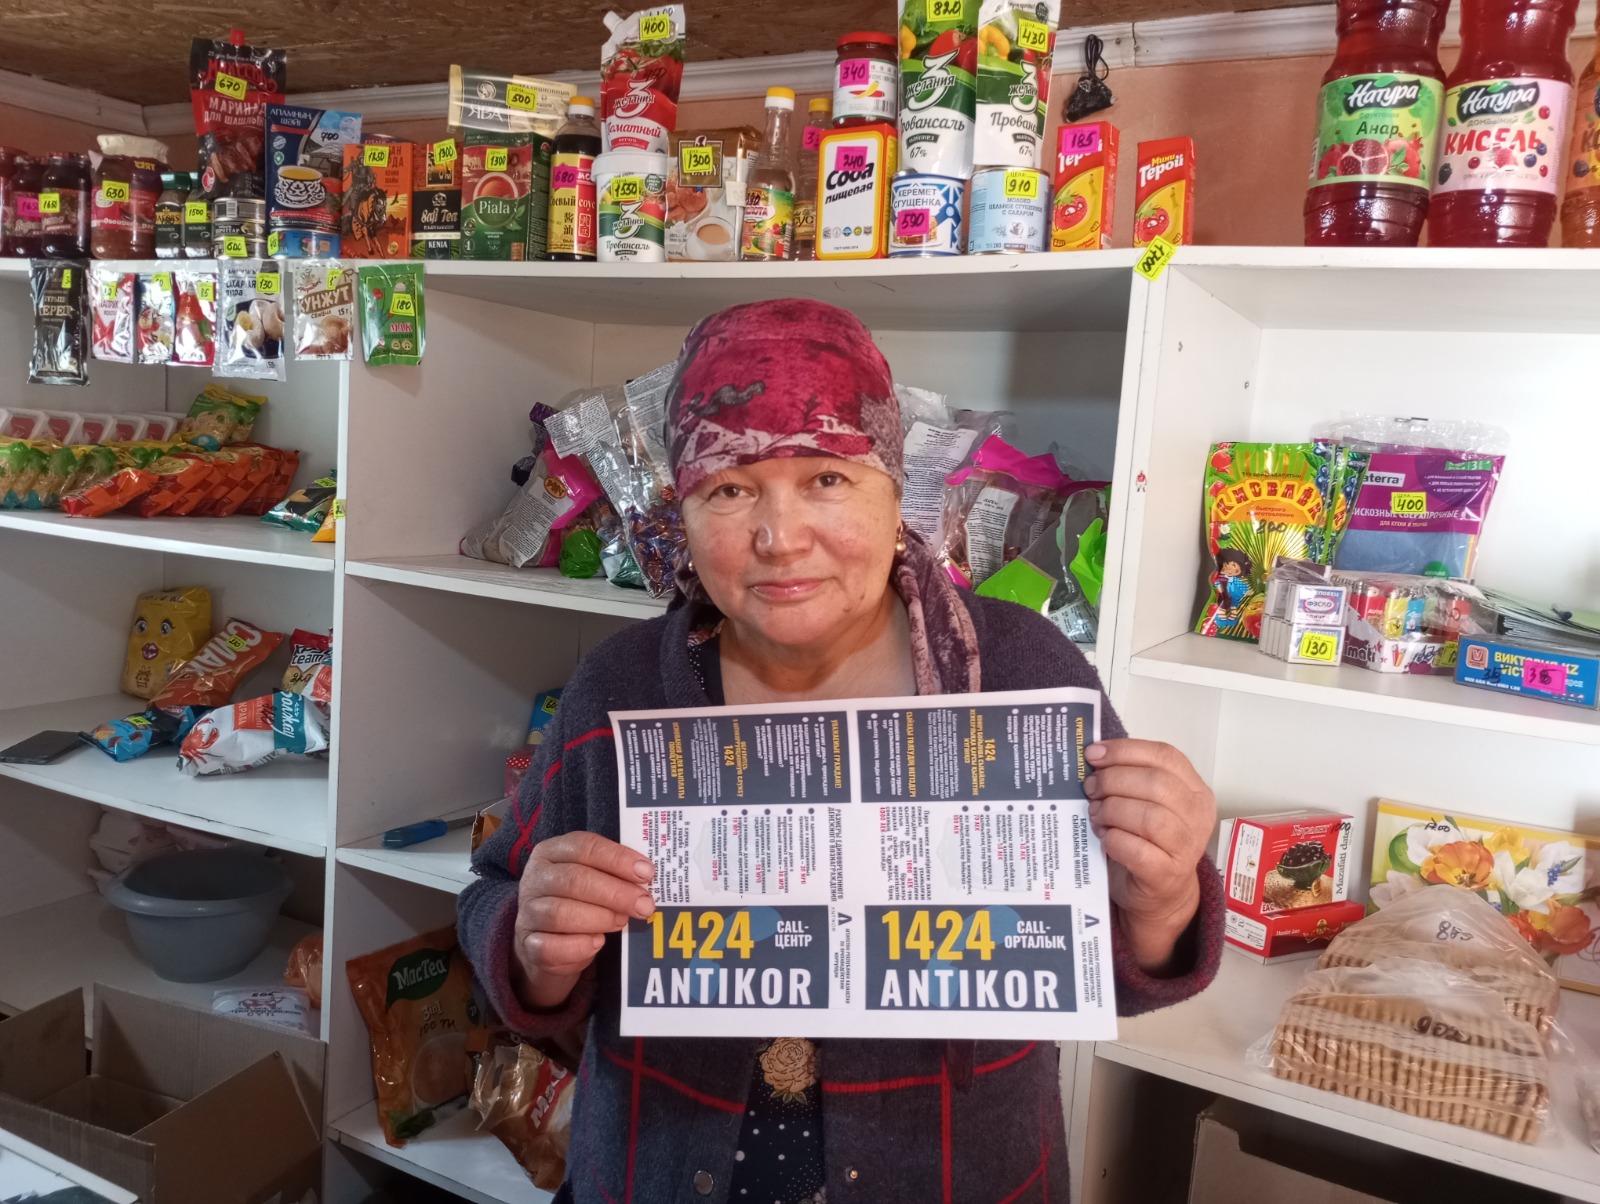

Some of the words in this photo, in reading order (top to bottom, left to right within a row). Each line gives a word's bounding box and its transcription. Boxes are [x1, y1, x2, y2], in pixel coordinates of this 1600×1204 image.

[933, 1, 961, 16] 820
[644, 20, 666, 34] 400
[1022, 28, 1046, 45] 430
[842, 64, 866, 80] 340
[218, 78, 240, 91] 670
[906, 74, 956, 98] желания
[908, 48, 960, 112] 3
[615, 78, 657, 118] 3
[1009, 84, 1038, 98] желан
[1347, 82, 1419, 108] Натура
[512, 94, 531, 104] 500
[614, 95, 655, 108] желания
[1461, 86, 1537, 116] Натура
[468, 104, 503, 122] ЯВА
[901, 115, 965, 132] ровансаль
[1356, 121, 1400, 138] Анар
[1467, 116, 1519, 128] домашний
[608, 122, 661, 138] Томатный
[1071, 132, 1097, 148] 185
[1444, 128, 1542, 156] КИСЕЛЬ
[490, 156, 506, 166] 1300
[688, 154, 710, 168] 1300
[843, 154, 864, 168] 240
[1152, 154, 1176, 166] Мини
[554, 170, 575, 183] 680
[106, 188, 124, 198] 630
[898, 188, 937, 198] КЕРЕМЕТ
[1008, 179, 1031, 192] 910
[825, 182, 874, 205] пищевая
[188, 208, 204, 216] 1500
[479, 200, 510, 214] Piala
[440, 210, 458, 222] Tea
[614, 201, 644, 239] 3
[428, 240, 448, 248] KENIA
[606, 241, 650, 254] Провансаль
[298, 286, 350, 312] КУНЖУТ
[396, 300, 412, 310] 180
[1396, 498, 1424, 510] 400
[1352, 508, 1398, 518] ИСКОЗНЫЕ
[1306, 640, 1328, 655] 130
[724, 745, 734, 766] 1424
[985, 739, 995, 761] 1424
[1081, 854, 1090, 885] АҚШАЛАЙ
[1336, 854, 1348, 894] Mazafati
[1262, 902, 1275, 912] EAC
[777, 920, 810, 934] CALL-
[1016, 920, 1051, 934] CALL-
[646, 911, 755, 959] 1424
[775, 934, 812, 950] ЦЕНТР
[882, 910, 996, 960] 1424
[1004, 935, 1066, 951] ОРТАЛЫҚ
[392, 956, 447, 990] MacTea
[644, 968, 812, 1006] ANTIKOR
[880, 969, 1060, 1008] ANTIKOR
